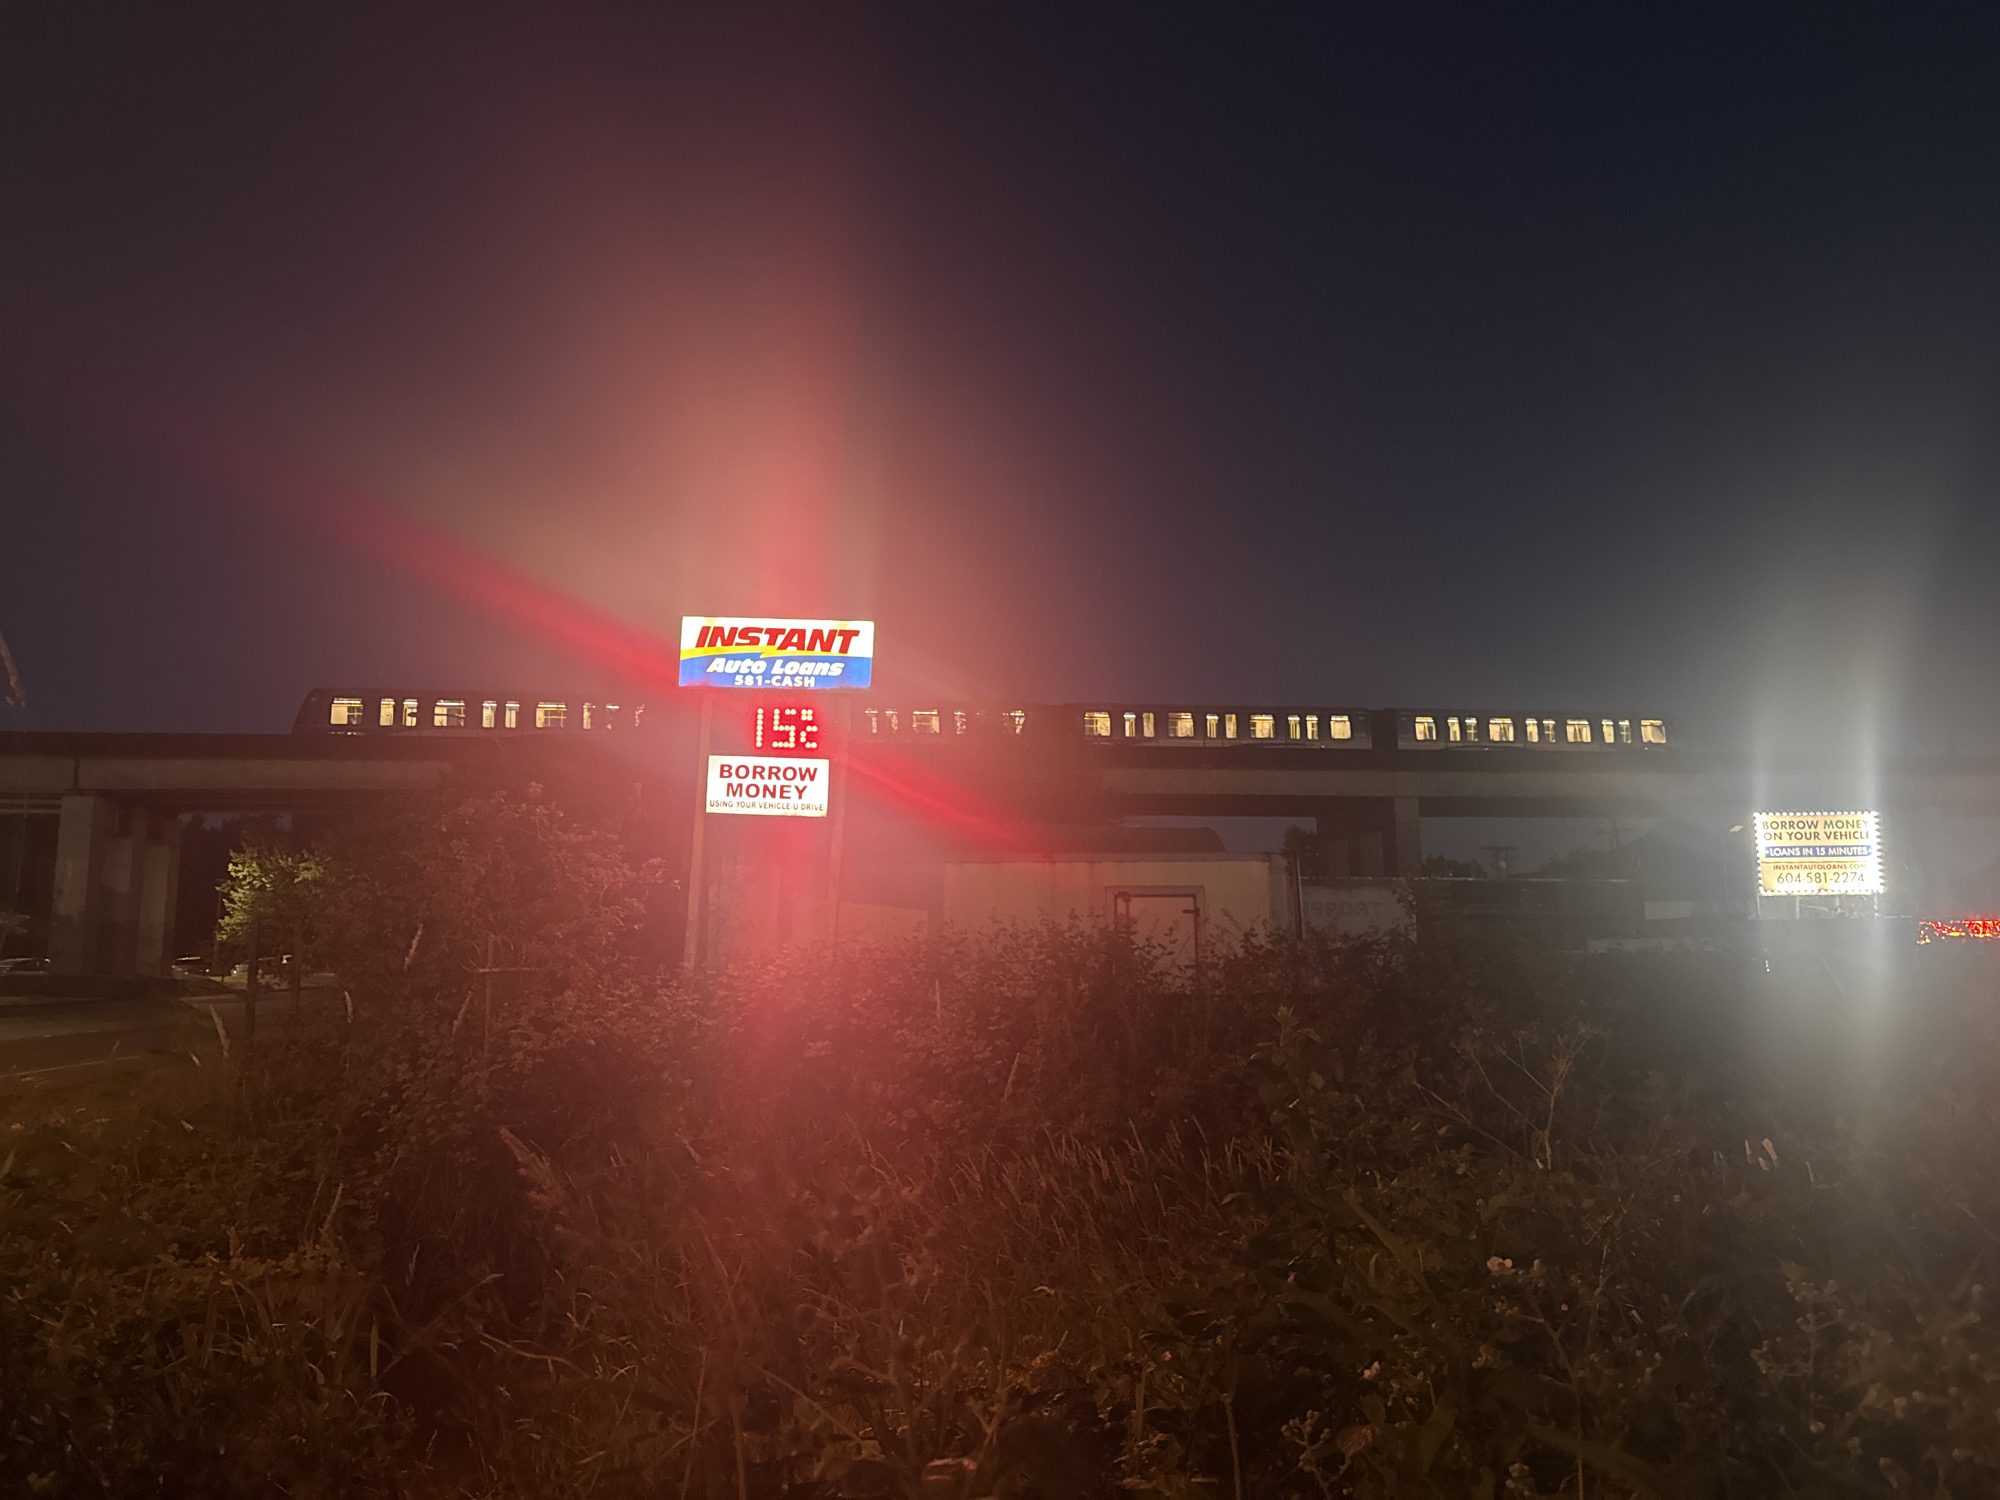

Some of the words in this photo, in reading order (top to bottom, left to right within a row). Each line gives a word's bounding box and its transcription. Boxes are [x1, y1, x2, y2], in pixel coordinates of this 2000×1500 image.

[695, 625, 860, 654] INSTANT
[706, 657, 767, 674] Auto
[770, 659, 845, 676] Loans
[734, 674, 815, 687] 581-CASH
[719, 764, 818, 781] BORROW
[726, 783, 808, 799] MONEY
[801, 803, 824, 811] DRIVE
[1762, 820, 1819, 830] BORROW
[1823, 820, 1868, 829] MONEY
[1763, 832, 1782, 841] ON
[1786, 831, 1821, 841] YOUR
[1824, 831, 1869, 840] VEHICLE
[1769, 847, 1801, 857] LOANS
[1802, 847, 1813, 856] IN
[1815, 847, 1826, 856] 15
[1828, 846, 1868, 856] MINUTES
[1776, 872, 1864, 884] 604-581-2274
